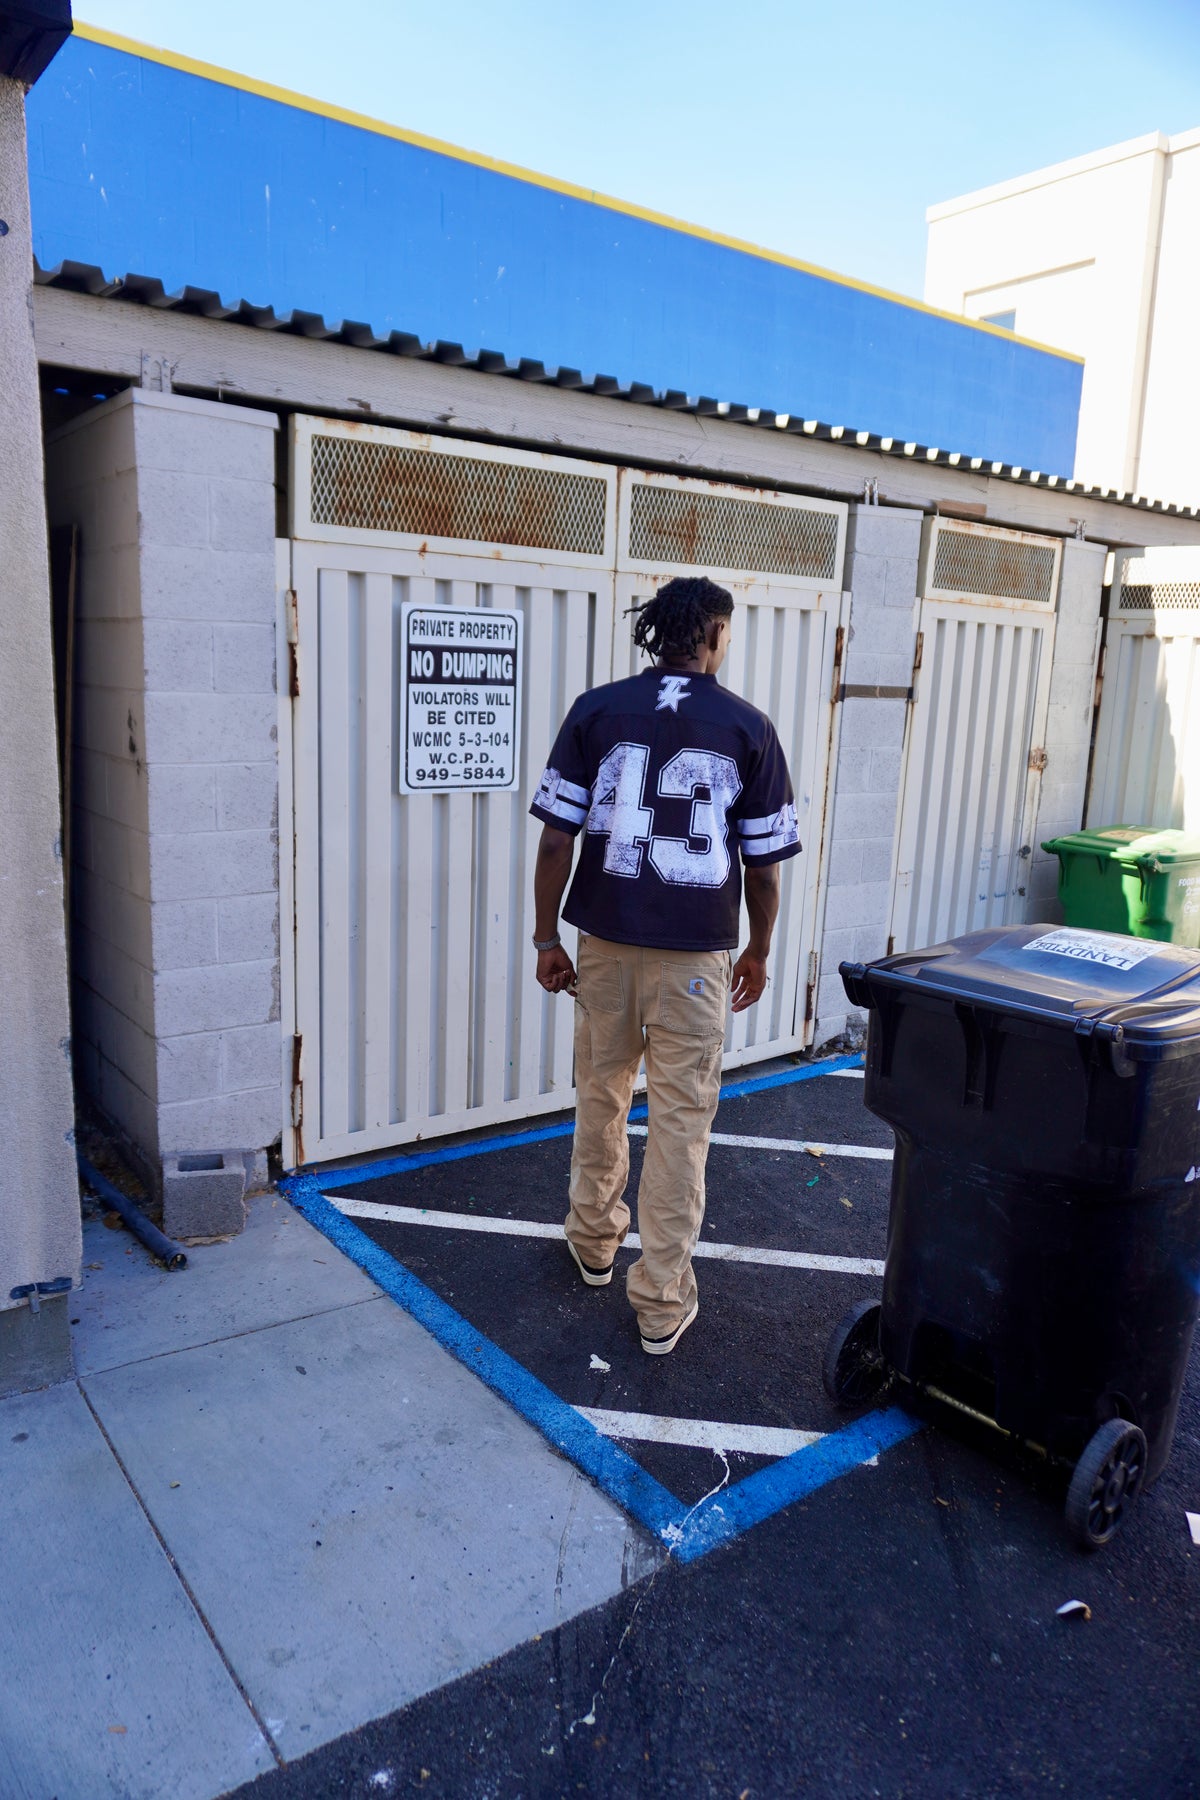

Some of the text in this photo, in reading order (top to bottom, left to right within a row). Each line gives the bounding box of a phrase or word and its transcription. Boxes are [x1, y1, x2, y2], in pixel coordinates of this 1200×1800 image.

[412, 618, 513, 641] PRIVATE PROPERTY
[411, 650, 513, 680] NO DUMPING
[412, 691, 511, 706] VIOLATORS WILL
[427, 710, 496, 725] BE CITED
[412, 732, 510, 747] WCMC 5-3-104
[429, 752, 494, 765] W.C.P.D.
[415, 766, 506, 781] 949-5844
[586, 741, 743, 888] 43
